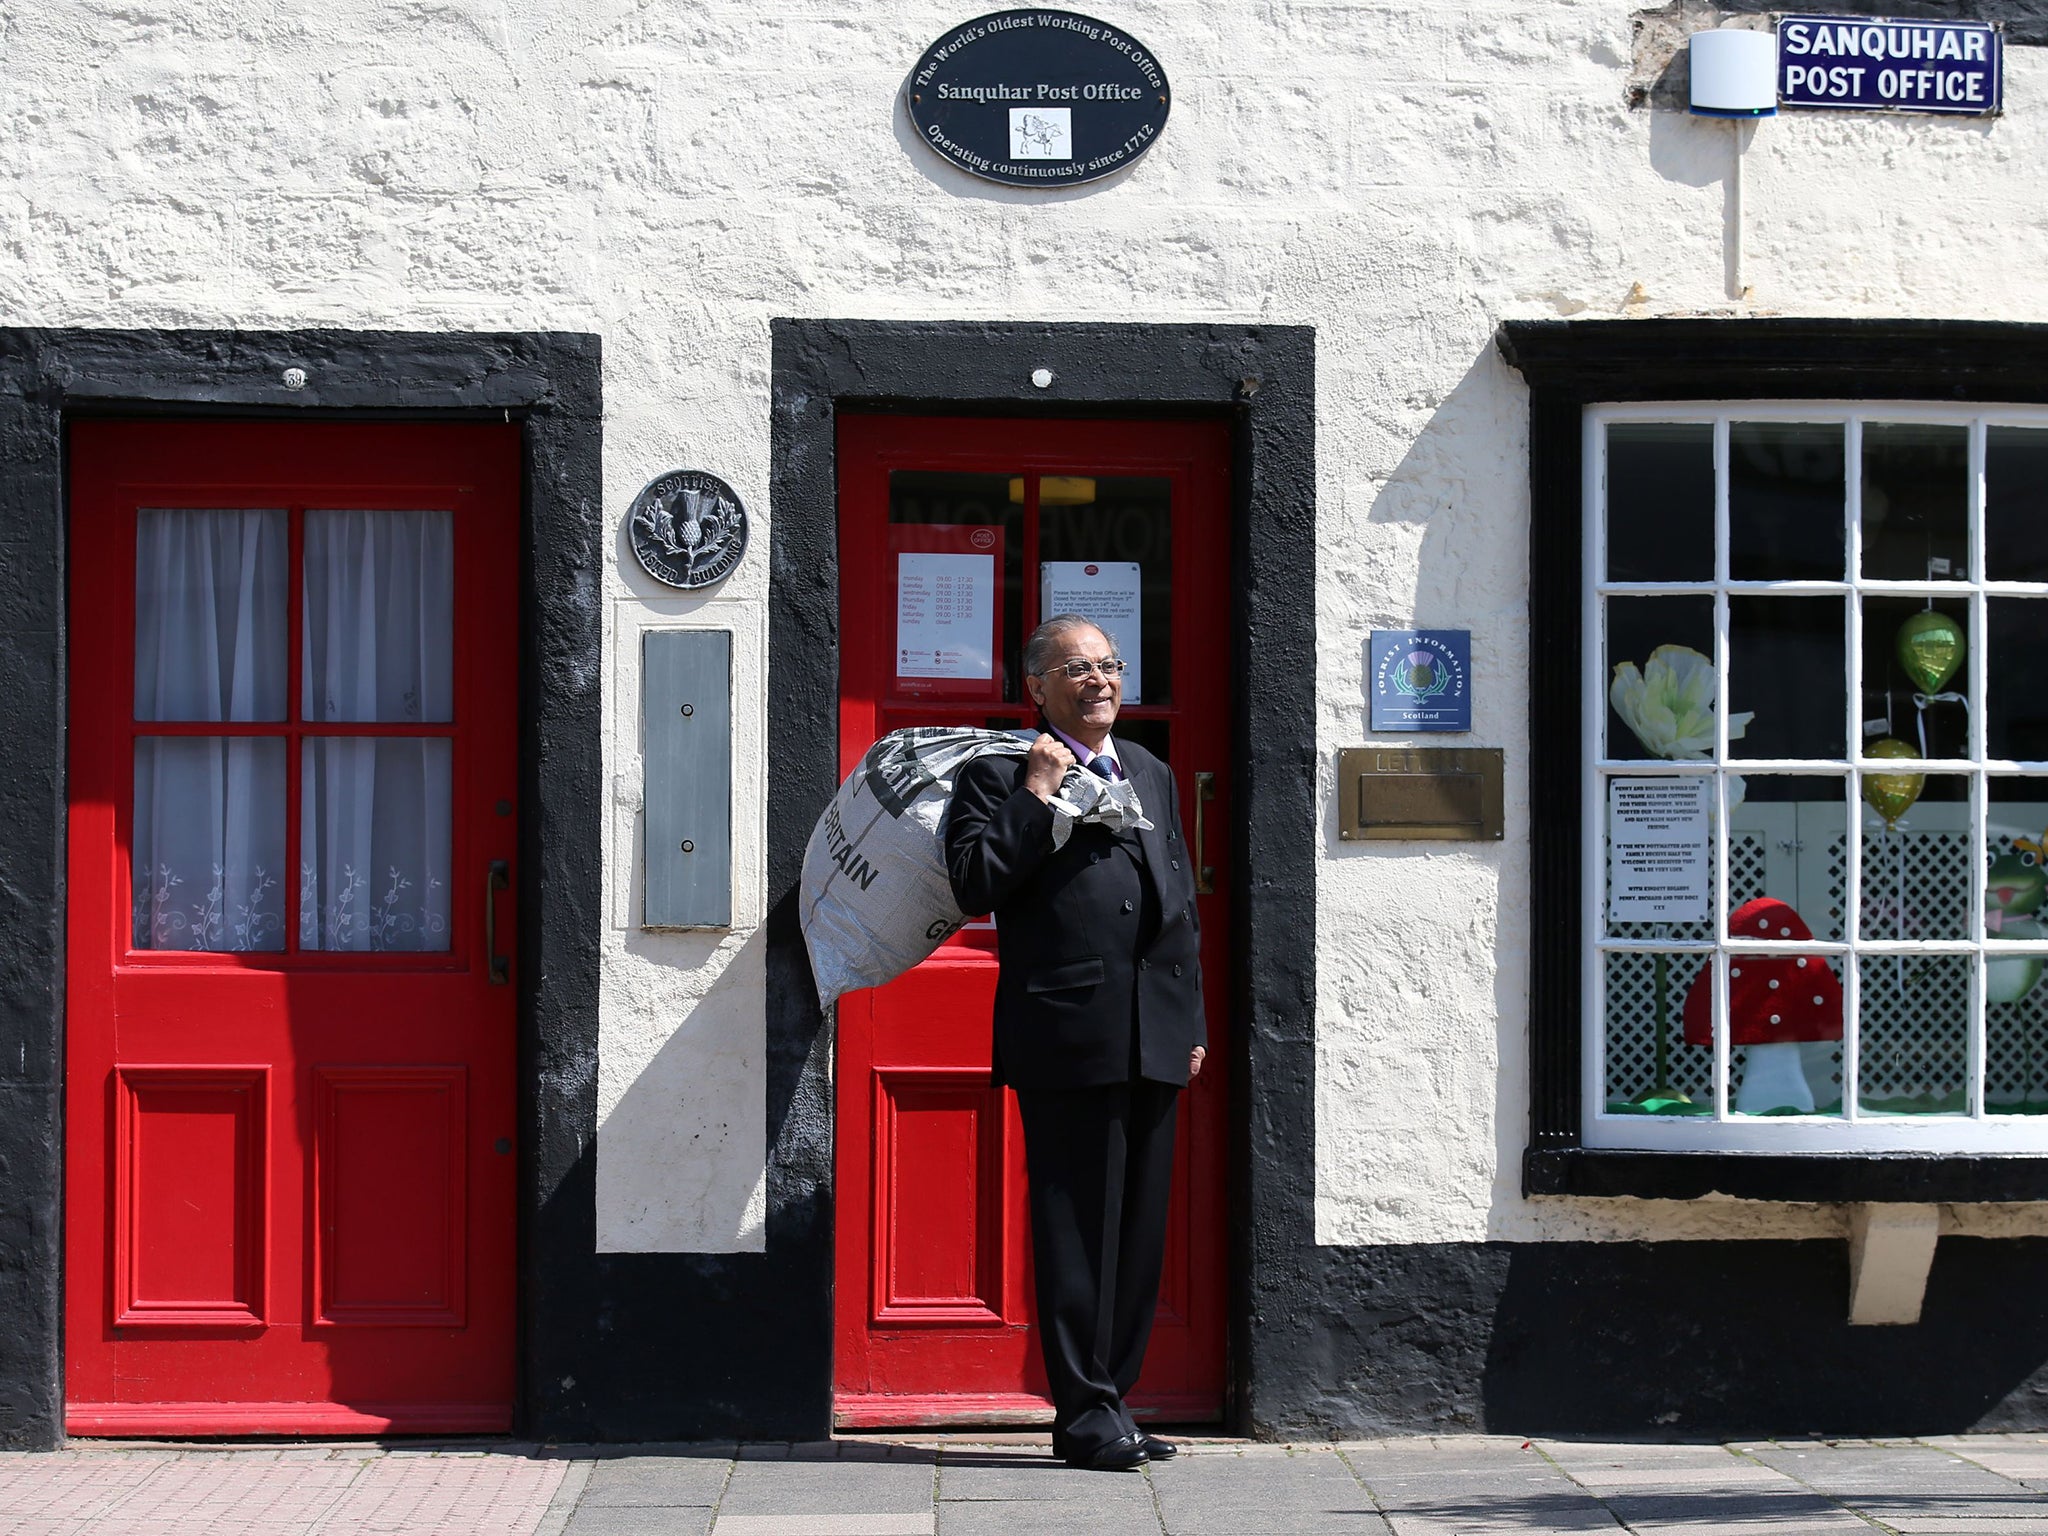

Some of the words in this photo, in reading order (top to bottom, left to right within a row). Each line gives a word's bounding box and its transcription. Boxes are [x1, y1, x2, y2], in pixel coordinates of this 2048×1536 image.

[915, 61, 938, 88] The
[934, 27, 986, 63] World's
[987, 15, 1034, 33] Oldest
[1037, 15, 1100, 40] Working
[1101, 30, 1132, 56] Post
[1131, 51, 1161, 89] Office
[1786, 24, 1986, 62] SANQUHAR
[937, 83, 1032, 103] Sanquhar
[1036, 83, 1079, 100] Post
[1083, 83, 1142, 100] Office
[1786, 65, 1865, 97] POST
[1877, 68, 1985, 102] OFFICE
[928, 124, 989, 171] Operating
[992, 162, 1086, 178] continuously
[1088, 149, 1125, 171] since
[1124, 124, 1154, 154] 1712
[288, 373, 302, 386] 39
[657, 475, 722, 496] SCOTTISH
[638, 541, 679, 581] LISTED
[692, 540, 742, 583] BUILDING
[1378, 644, 1400, 696] TOURIST
[1408, 637, 1463, 697] INFORMATION
[824, 800, 880, 893] BRITAIN
